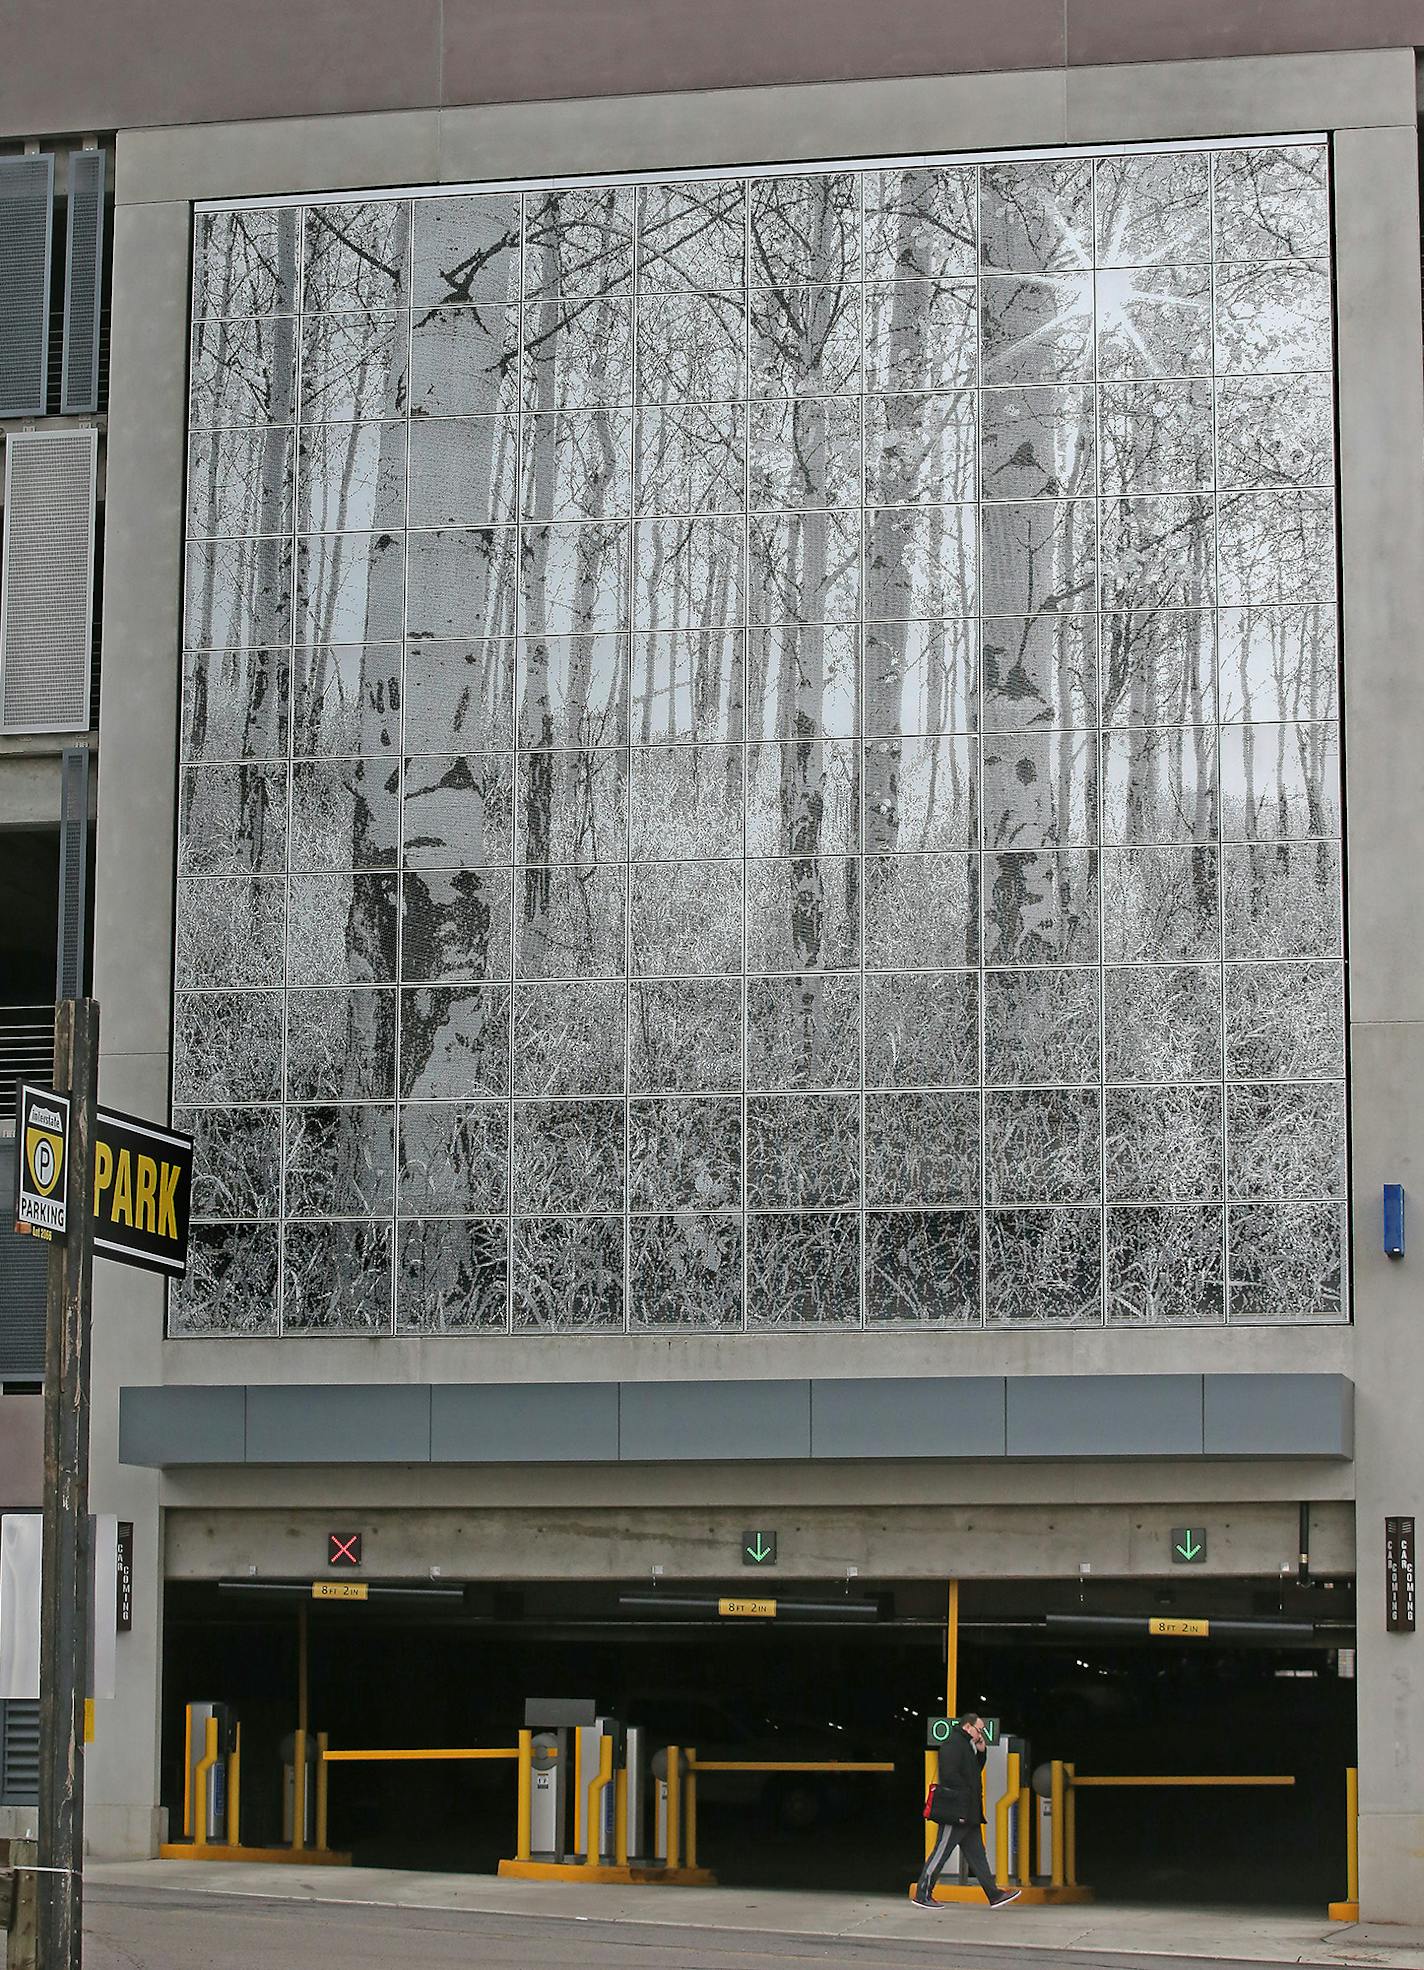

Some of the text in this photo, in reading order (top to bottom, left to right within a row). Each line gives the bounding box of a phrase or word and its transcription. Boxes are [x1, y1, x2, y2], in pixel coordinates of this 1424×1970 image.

[40, 1146, 51, 1180] P
[21, 1197, 65, 1227] PARKING
[94, 1141, 181, 1240] PARK
[122, 1565, 130, 1621] COMING
[1406, 1563, 1414, 1620] COMING
[932, 1719, 994, 1742] ON
